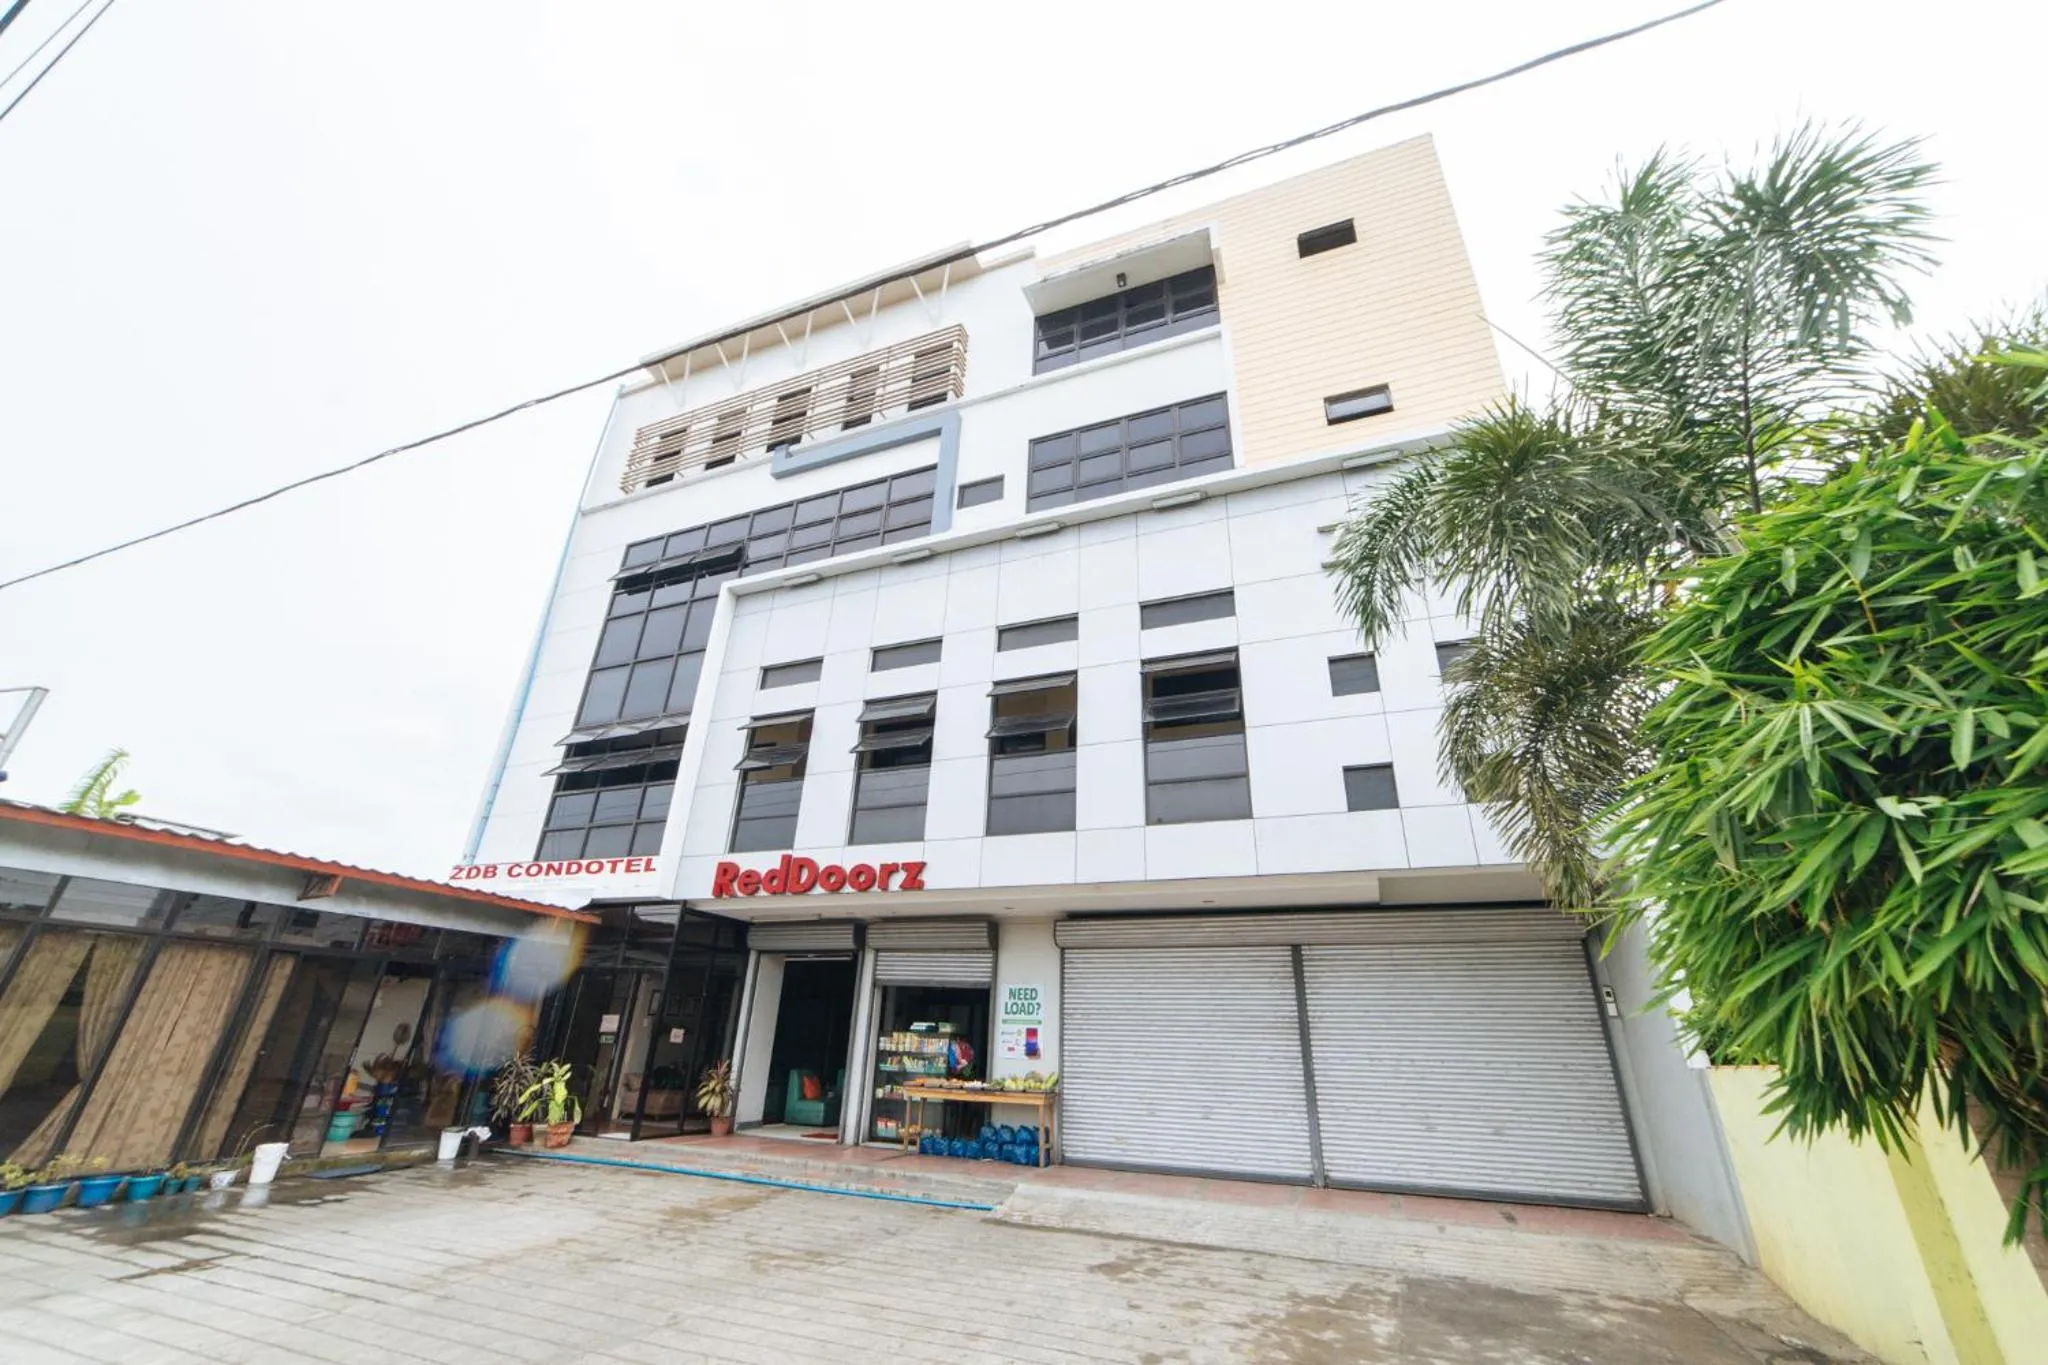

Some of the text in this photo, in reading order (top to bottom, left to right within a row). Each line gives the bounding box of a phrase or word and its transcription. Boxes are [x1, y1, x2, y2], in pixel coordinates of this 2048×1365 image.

[450, 857, 657, 880] ZDB CONDOTEL
[712, 854, 926, 898] RedDoorz
[1008, 987, 1038, 1001] NEED
[1004, 1002, 1041, 1015] LOAD?
